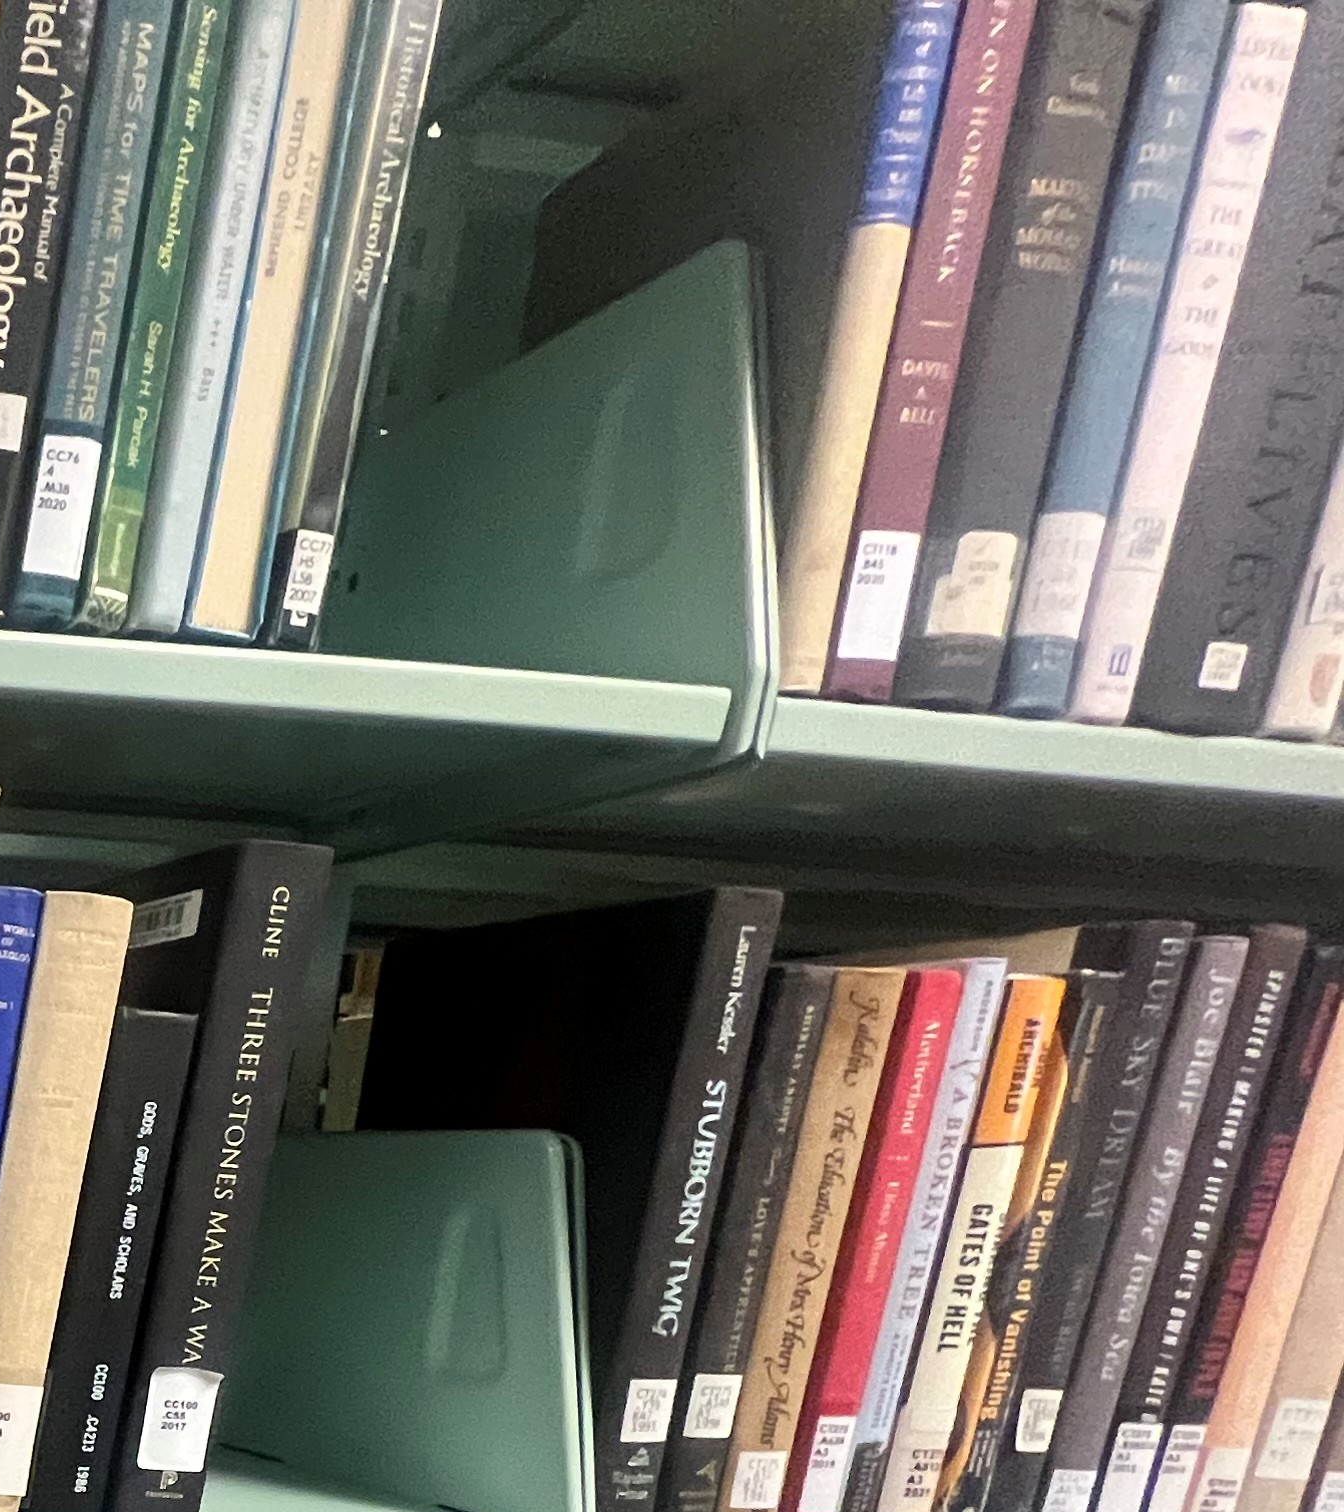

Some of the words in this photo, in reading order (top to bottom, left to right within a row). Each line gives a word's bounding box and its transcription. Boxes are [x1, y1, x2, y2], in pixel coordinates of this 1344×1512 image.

[260, 884, 291, 958] CLINE
[234, 984, 274, 1084] THREE
[135, 1100, 158, 1140] GODS,
[212, 1091, 253, 1201] STONES
[125, 1144, 150, 1197] GRAVES,
[676, 1078, 730, 1247] STUBBORN
[1040, 1158, 1068, 1203] The
[121, 1202, 139, 1231] AND
[195, 1209, 230, 1288] MAKE
[957, 1201, 994, 1269] GATES
[1022, 1208, 1055, 1272] Point
[108, 1234, 132, 1301] SCHOLARS
[651, 1252, 693, 1337] TWIG
[950, 1272, 976, 1299] OF
[1014, 1277, 1032, 1302] of
[189, 1295, 213, 1316] A
[935, 1302, 969, 1355] HELL
[981, 1306, 1029, 1424] Vanishing
